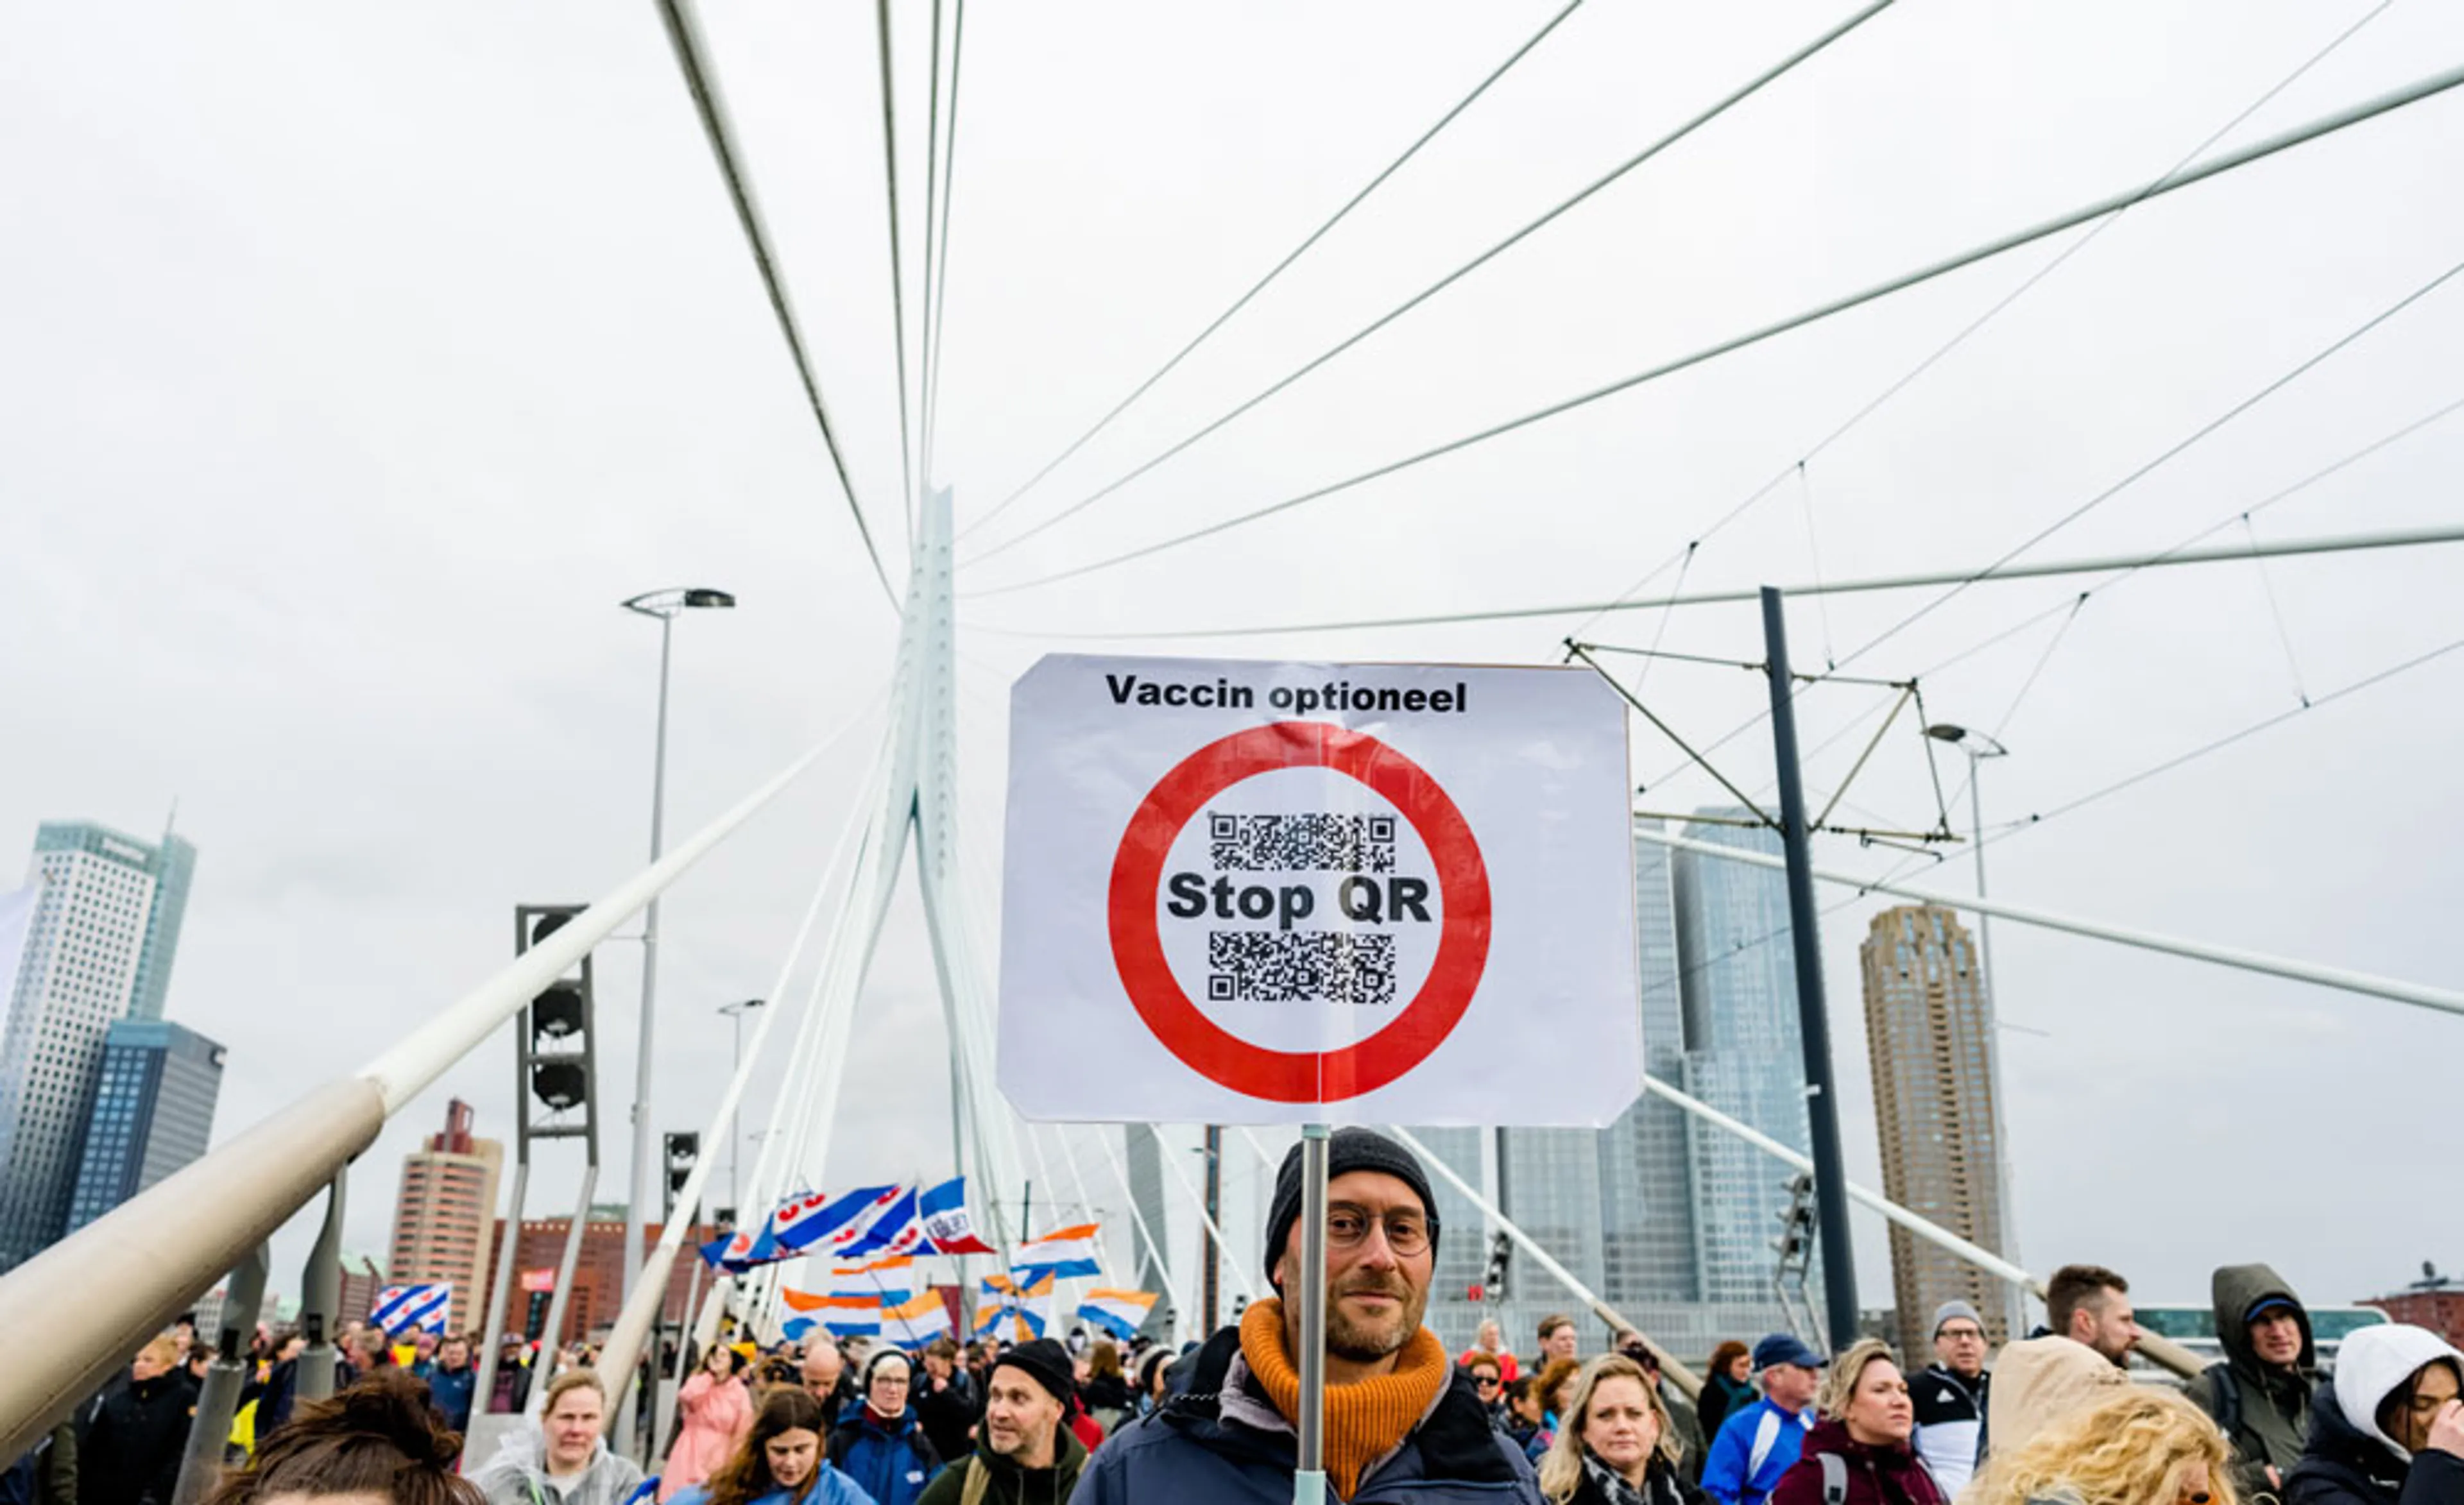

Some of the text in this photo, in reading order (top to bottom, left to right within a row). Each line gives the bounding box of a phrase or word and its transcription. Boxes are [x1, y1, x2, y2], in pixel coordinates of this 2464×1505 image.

[1106, 674, 1467, 715] Vaccin optioneel
[1167, 872, 1432, 931] Stop QR
